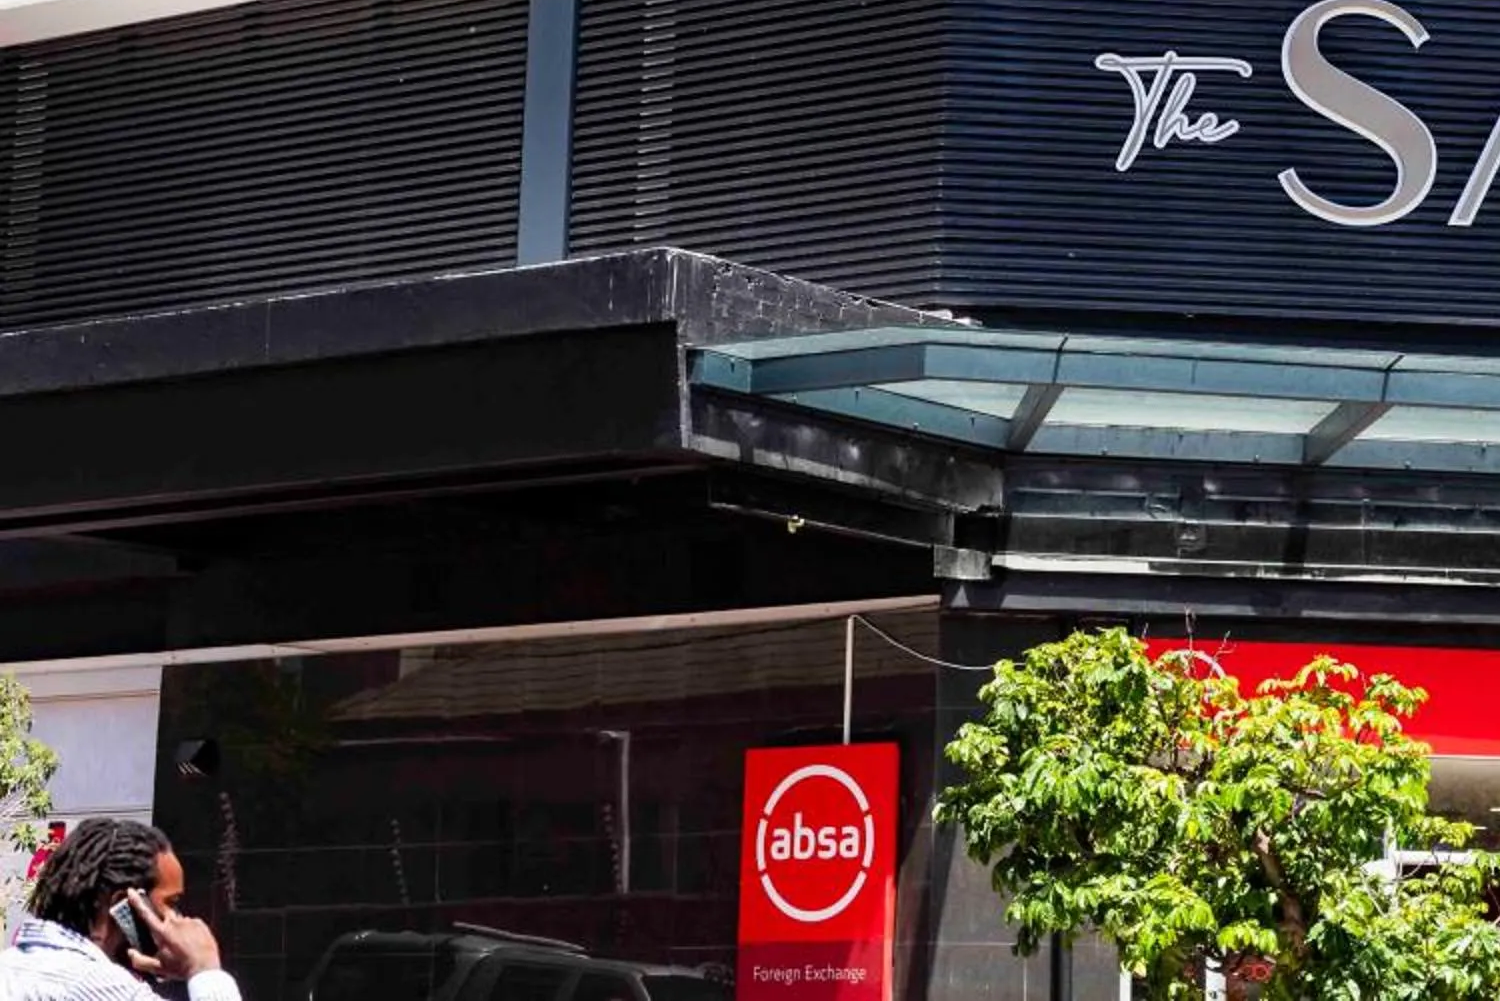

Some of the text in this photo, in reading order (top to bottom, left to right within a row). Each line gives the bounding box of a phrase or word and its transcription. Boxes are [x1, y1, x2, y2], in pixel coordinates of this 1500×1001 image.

[1094, 50, 1253, 172] The
[770, 812, 861, 861] absa
[753, 963, 867, 986] Foreign Exchange
